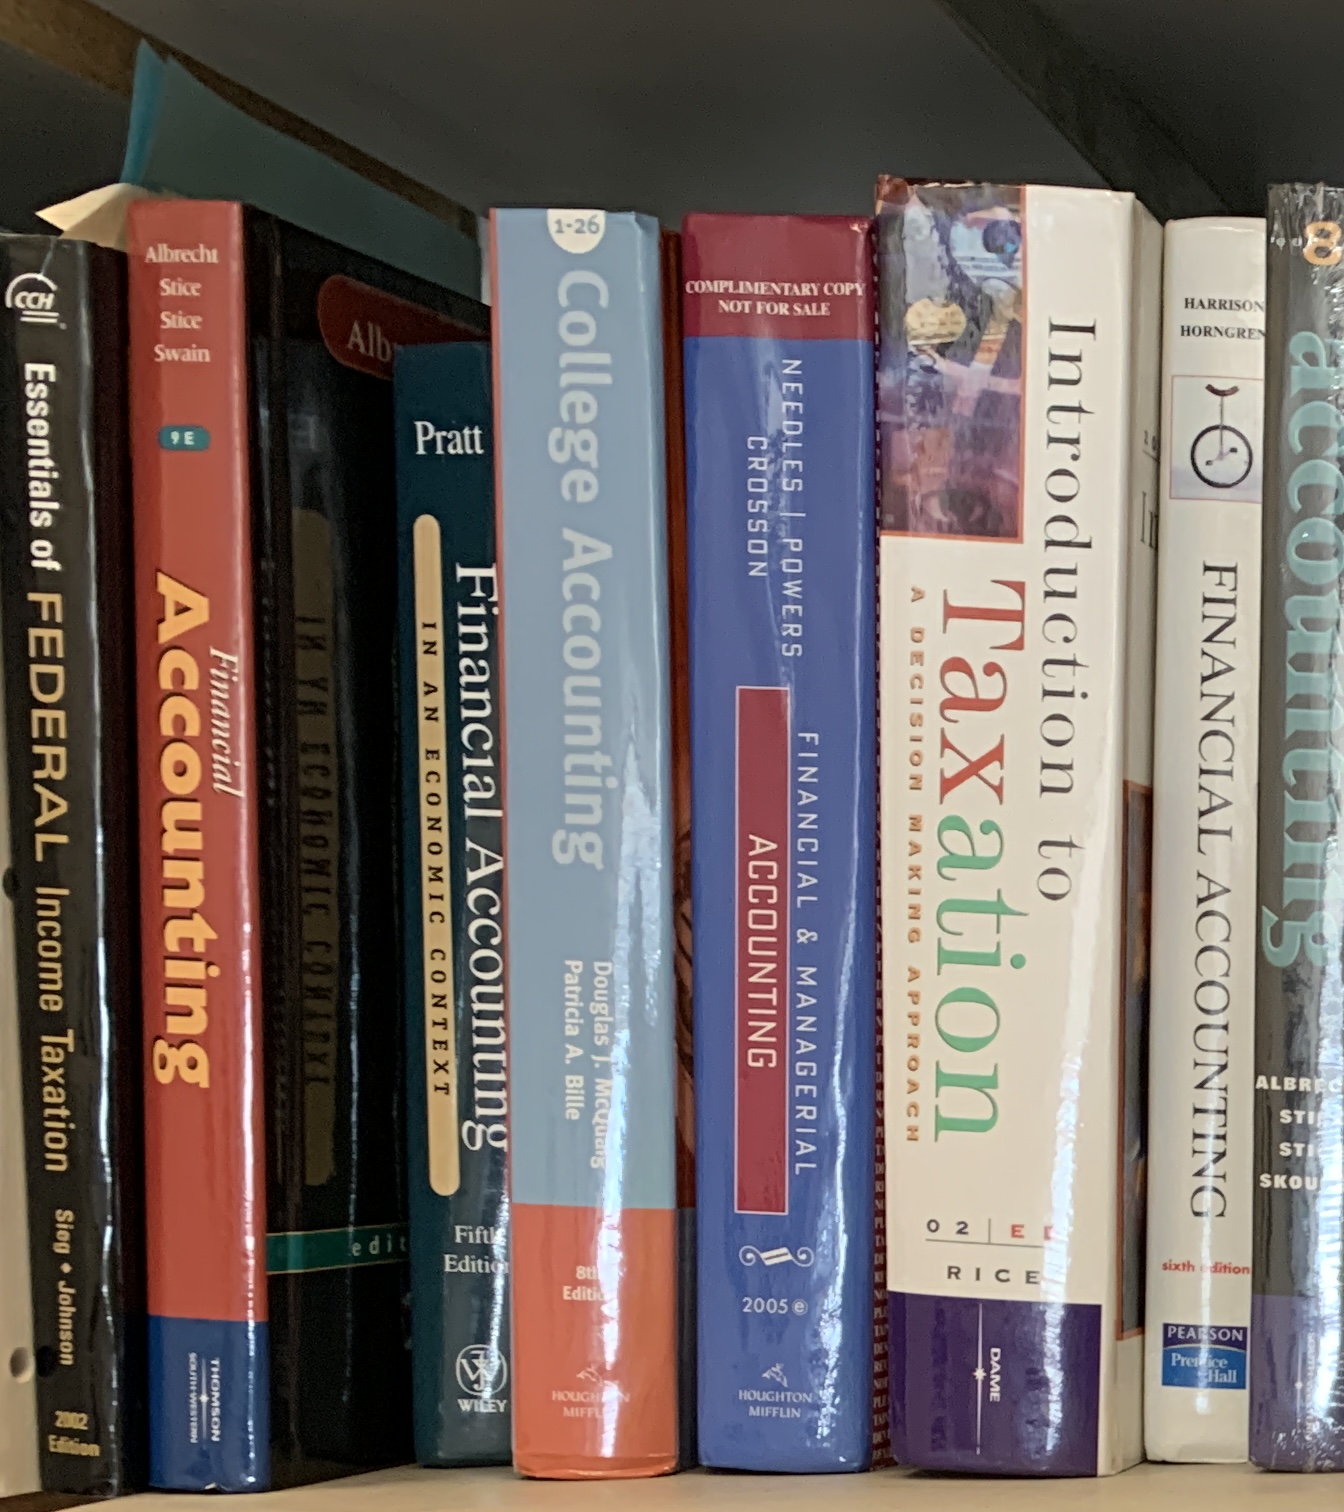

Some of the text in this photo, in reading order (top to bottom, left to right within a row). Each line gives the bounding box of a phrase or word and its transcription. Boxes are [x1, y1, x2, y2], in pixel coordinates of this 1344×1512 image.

[144, 244, 219, 265] Albrecht
[159, 278, 202, 297] Stice
[685, 279, 866, 296] COMPLIMENTARY COPY
[718, 300, 830, 316] NOT FOR SALE
[154, 344, 211, 363] Swain
[414, 421, 485, 455] Pratt
[547, 270, 619, 870] College Accounting
[1037, 316, 1099, 901] Introduction to
[25, 363, 69, 1172] Essentials of FEDERAL Income Taxation
[152, 570, 221, 1088] Accounting
[933, 578, 1030, 1143] Taxation
[1189, 562, 1239, 1219] FINANCIAL ACCOUNTING
[746, 834, 778, 1070] ACCOUNTING
[738, 1390, 812, 1403] HOUGHTON
[747, 1406, 801, 1418] MIFFLIN
